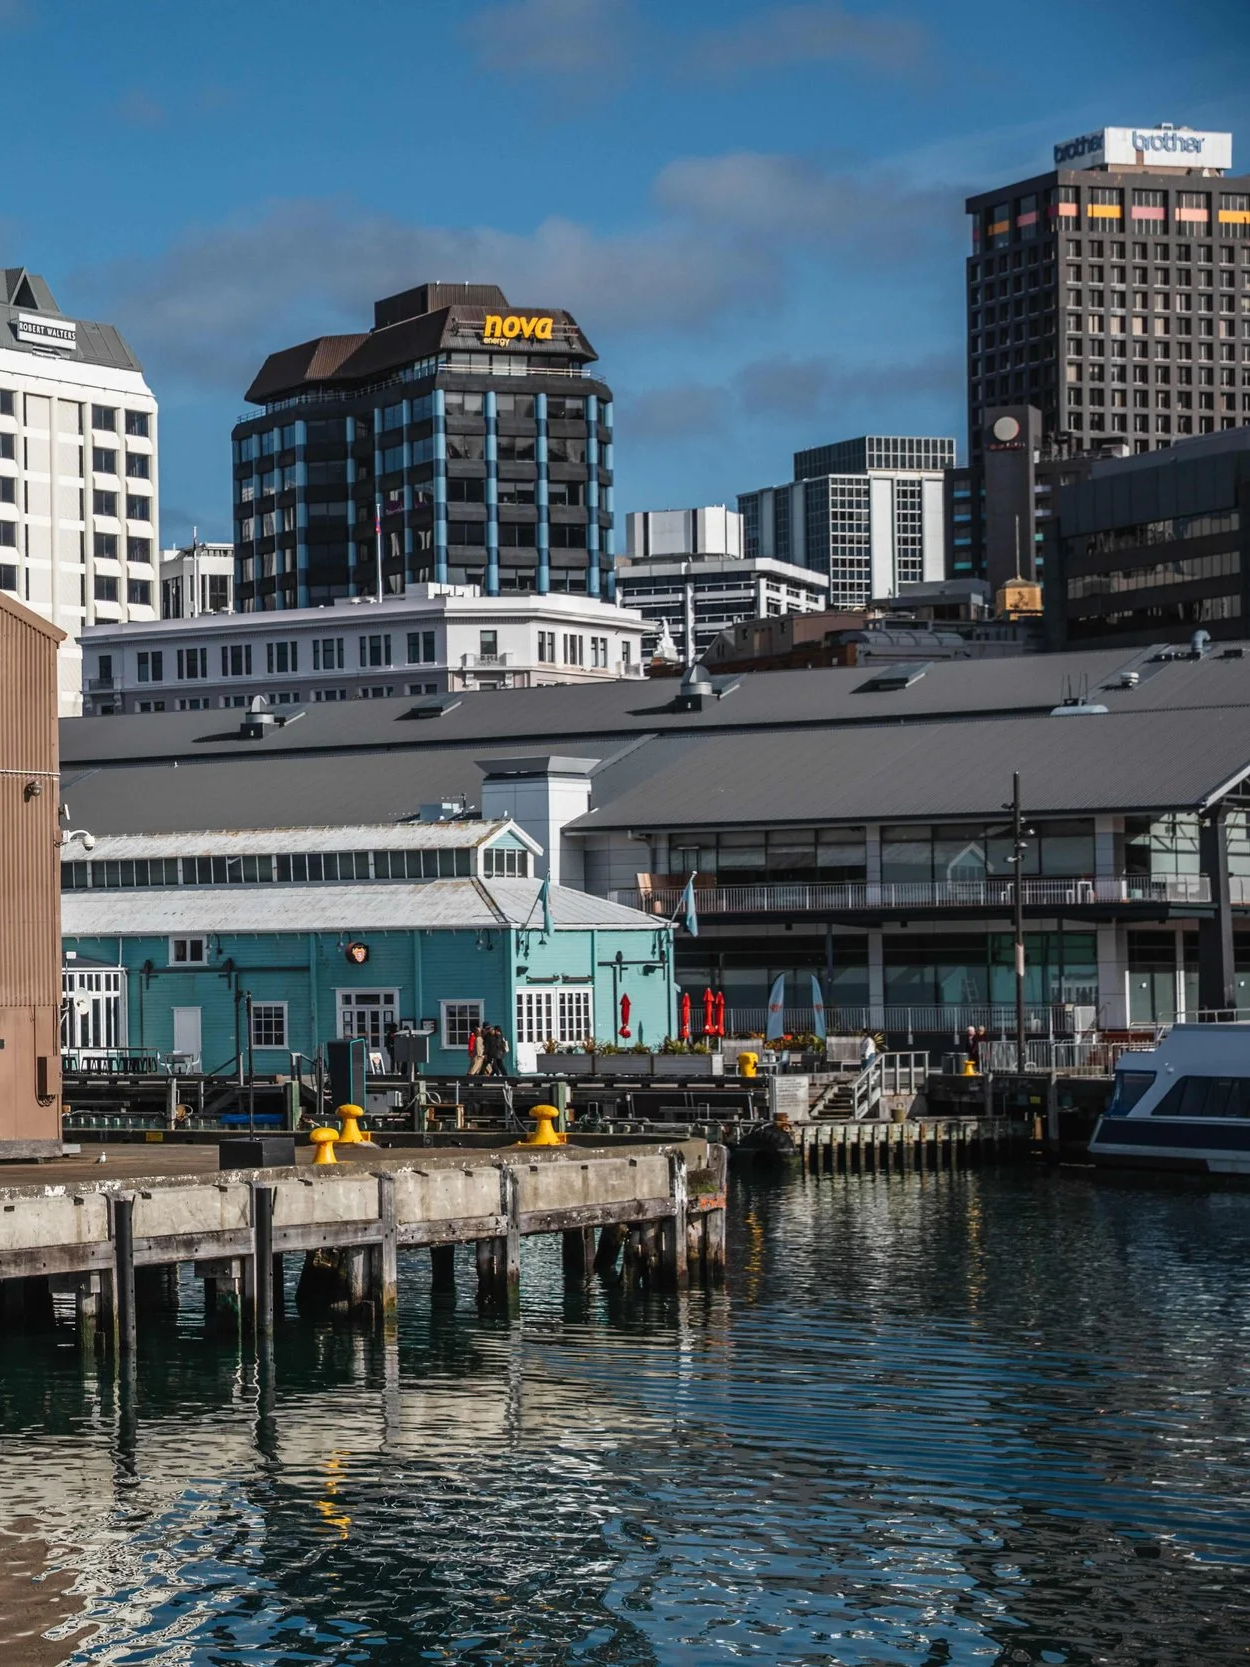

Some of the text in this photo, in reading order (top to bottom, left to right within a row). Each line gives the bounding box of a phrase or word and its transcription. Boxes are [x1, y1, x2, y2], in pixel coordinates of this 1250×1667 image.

[1132, 131, 1204, 153] brother
[19, 322, 76, 340] ROBERT WALTERS
[484, 315, 554, 339] nova
